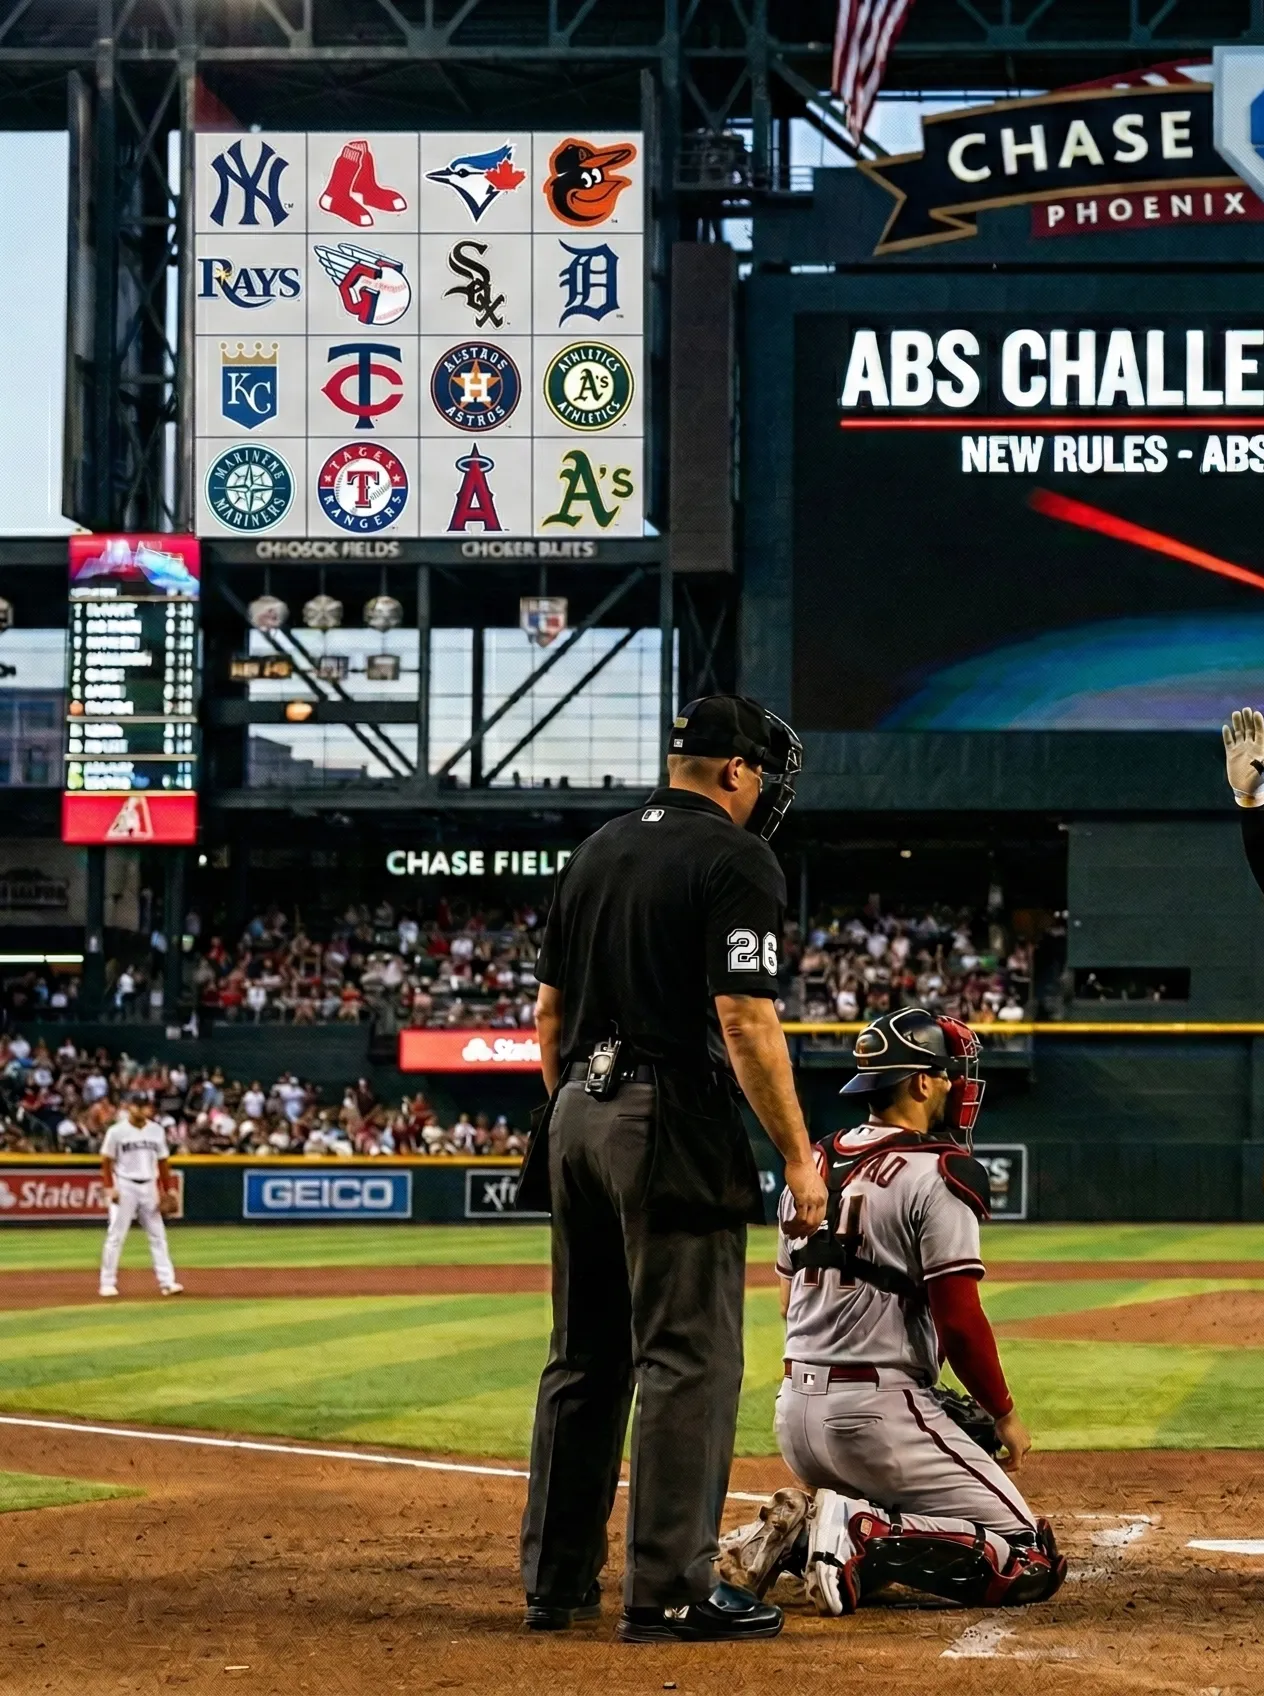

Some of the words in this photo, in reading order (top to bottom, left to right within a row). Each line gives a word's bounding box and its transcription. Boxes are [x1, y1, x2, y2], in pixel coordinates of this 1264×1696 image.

[947, 110, 1194, 183] CHASE
[1047, 191, 1246, 228] PHOENIX
[557, 349, 621, 372] ATHLETICS
[840, 328, 981, 408] ABS
[228, 373, 271, 414] KC
[445, 406, 506, 426] ASTROS
[557, 401, 621, 424] ATHLETICS
[961, 435, 1044, 473] NEW
[1053, 435, 1168, 473] RULES
[213, 497, 286, 527] MARINERS
[386, 850, 485, 876] CHASE
[262, 1178, 394, 1209] GEICO
